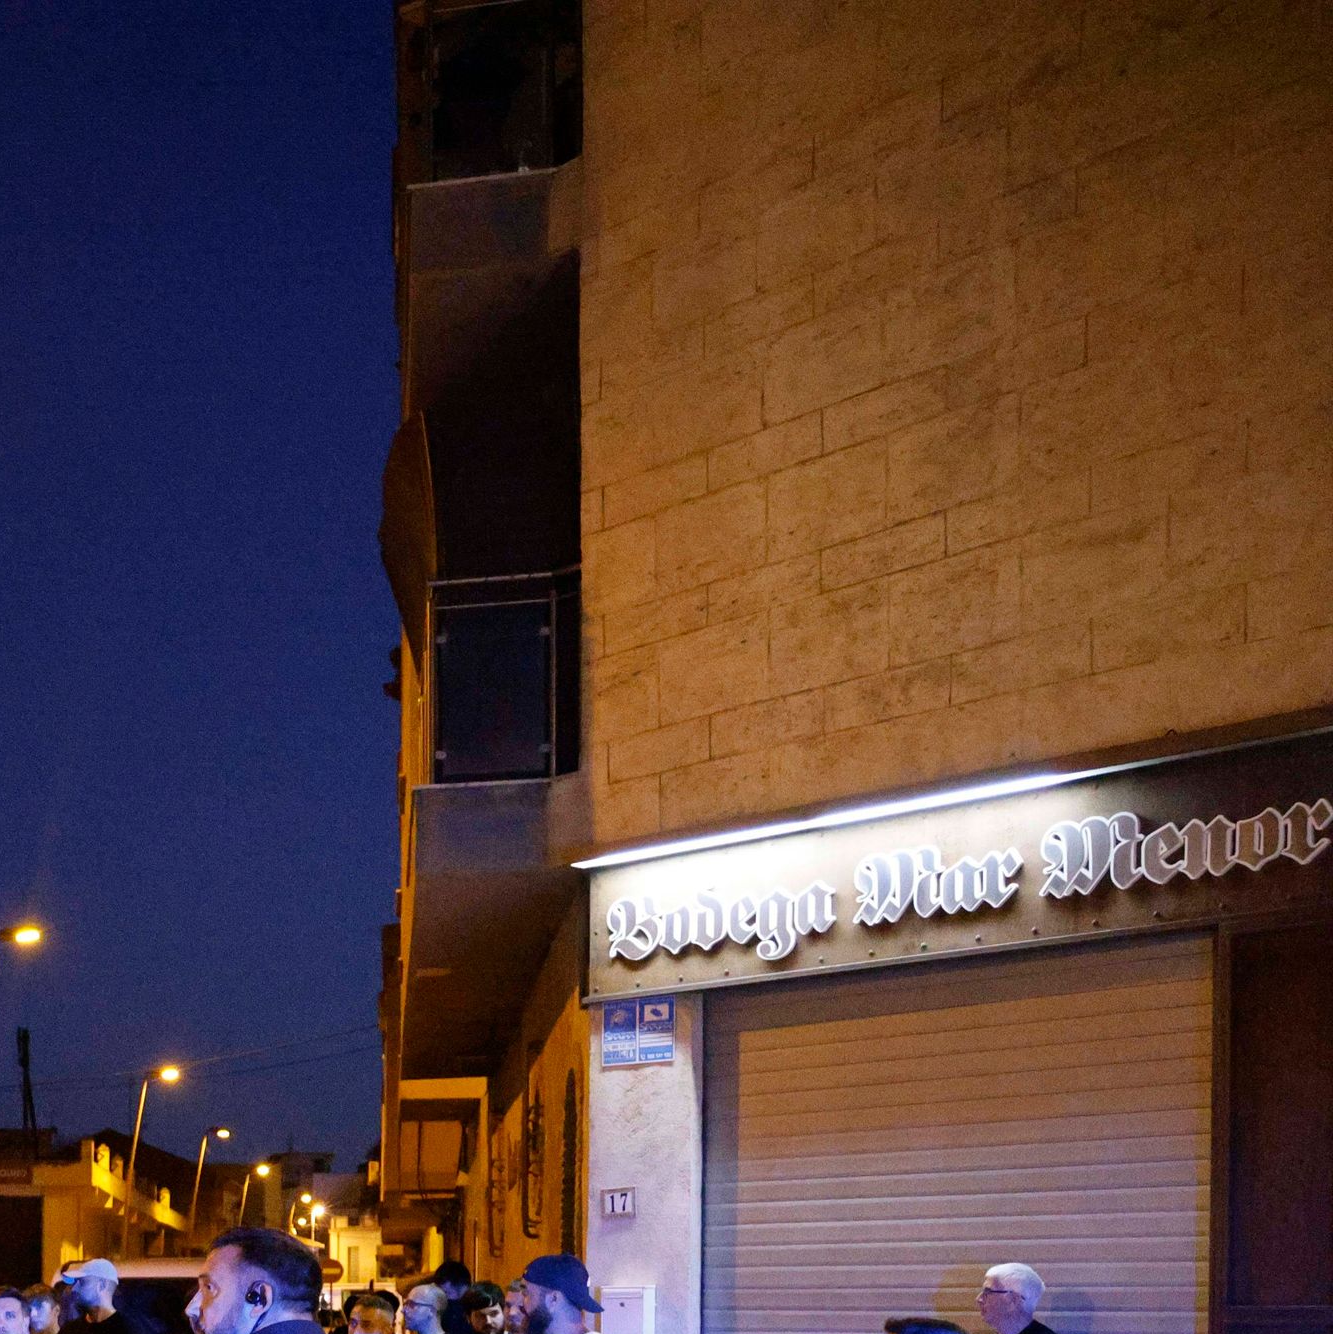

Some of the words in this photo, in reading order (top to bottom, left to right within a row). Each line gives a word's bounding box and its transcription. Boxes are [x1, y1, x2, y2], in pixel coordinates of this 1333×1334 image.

[605, 878, 838, 962] Bodega
[852, 844, 1026, 928] Mar
[1038, 796, 1333, 900] Menor
[609, 1192, 628, 1213] 17
